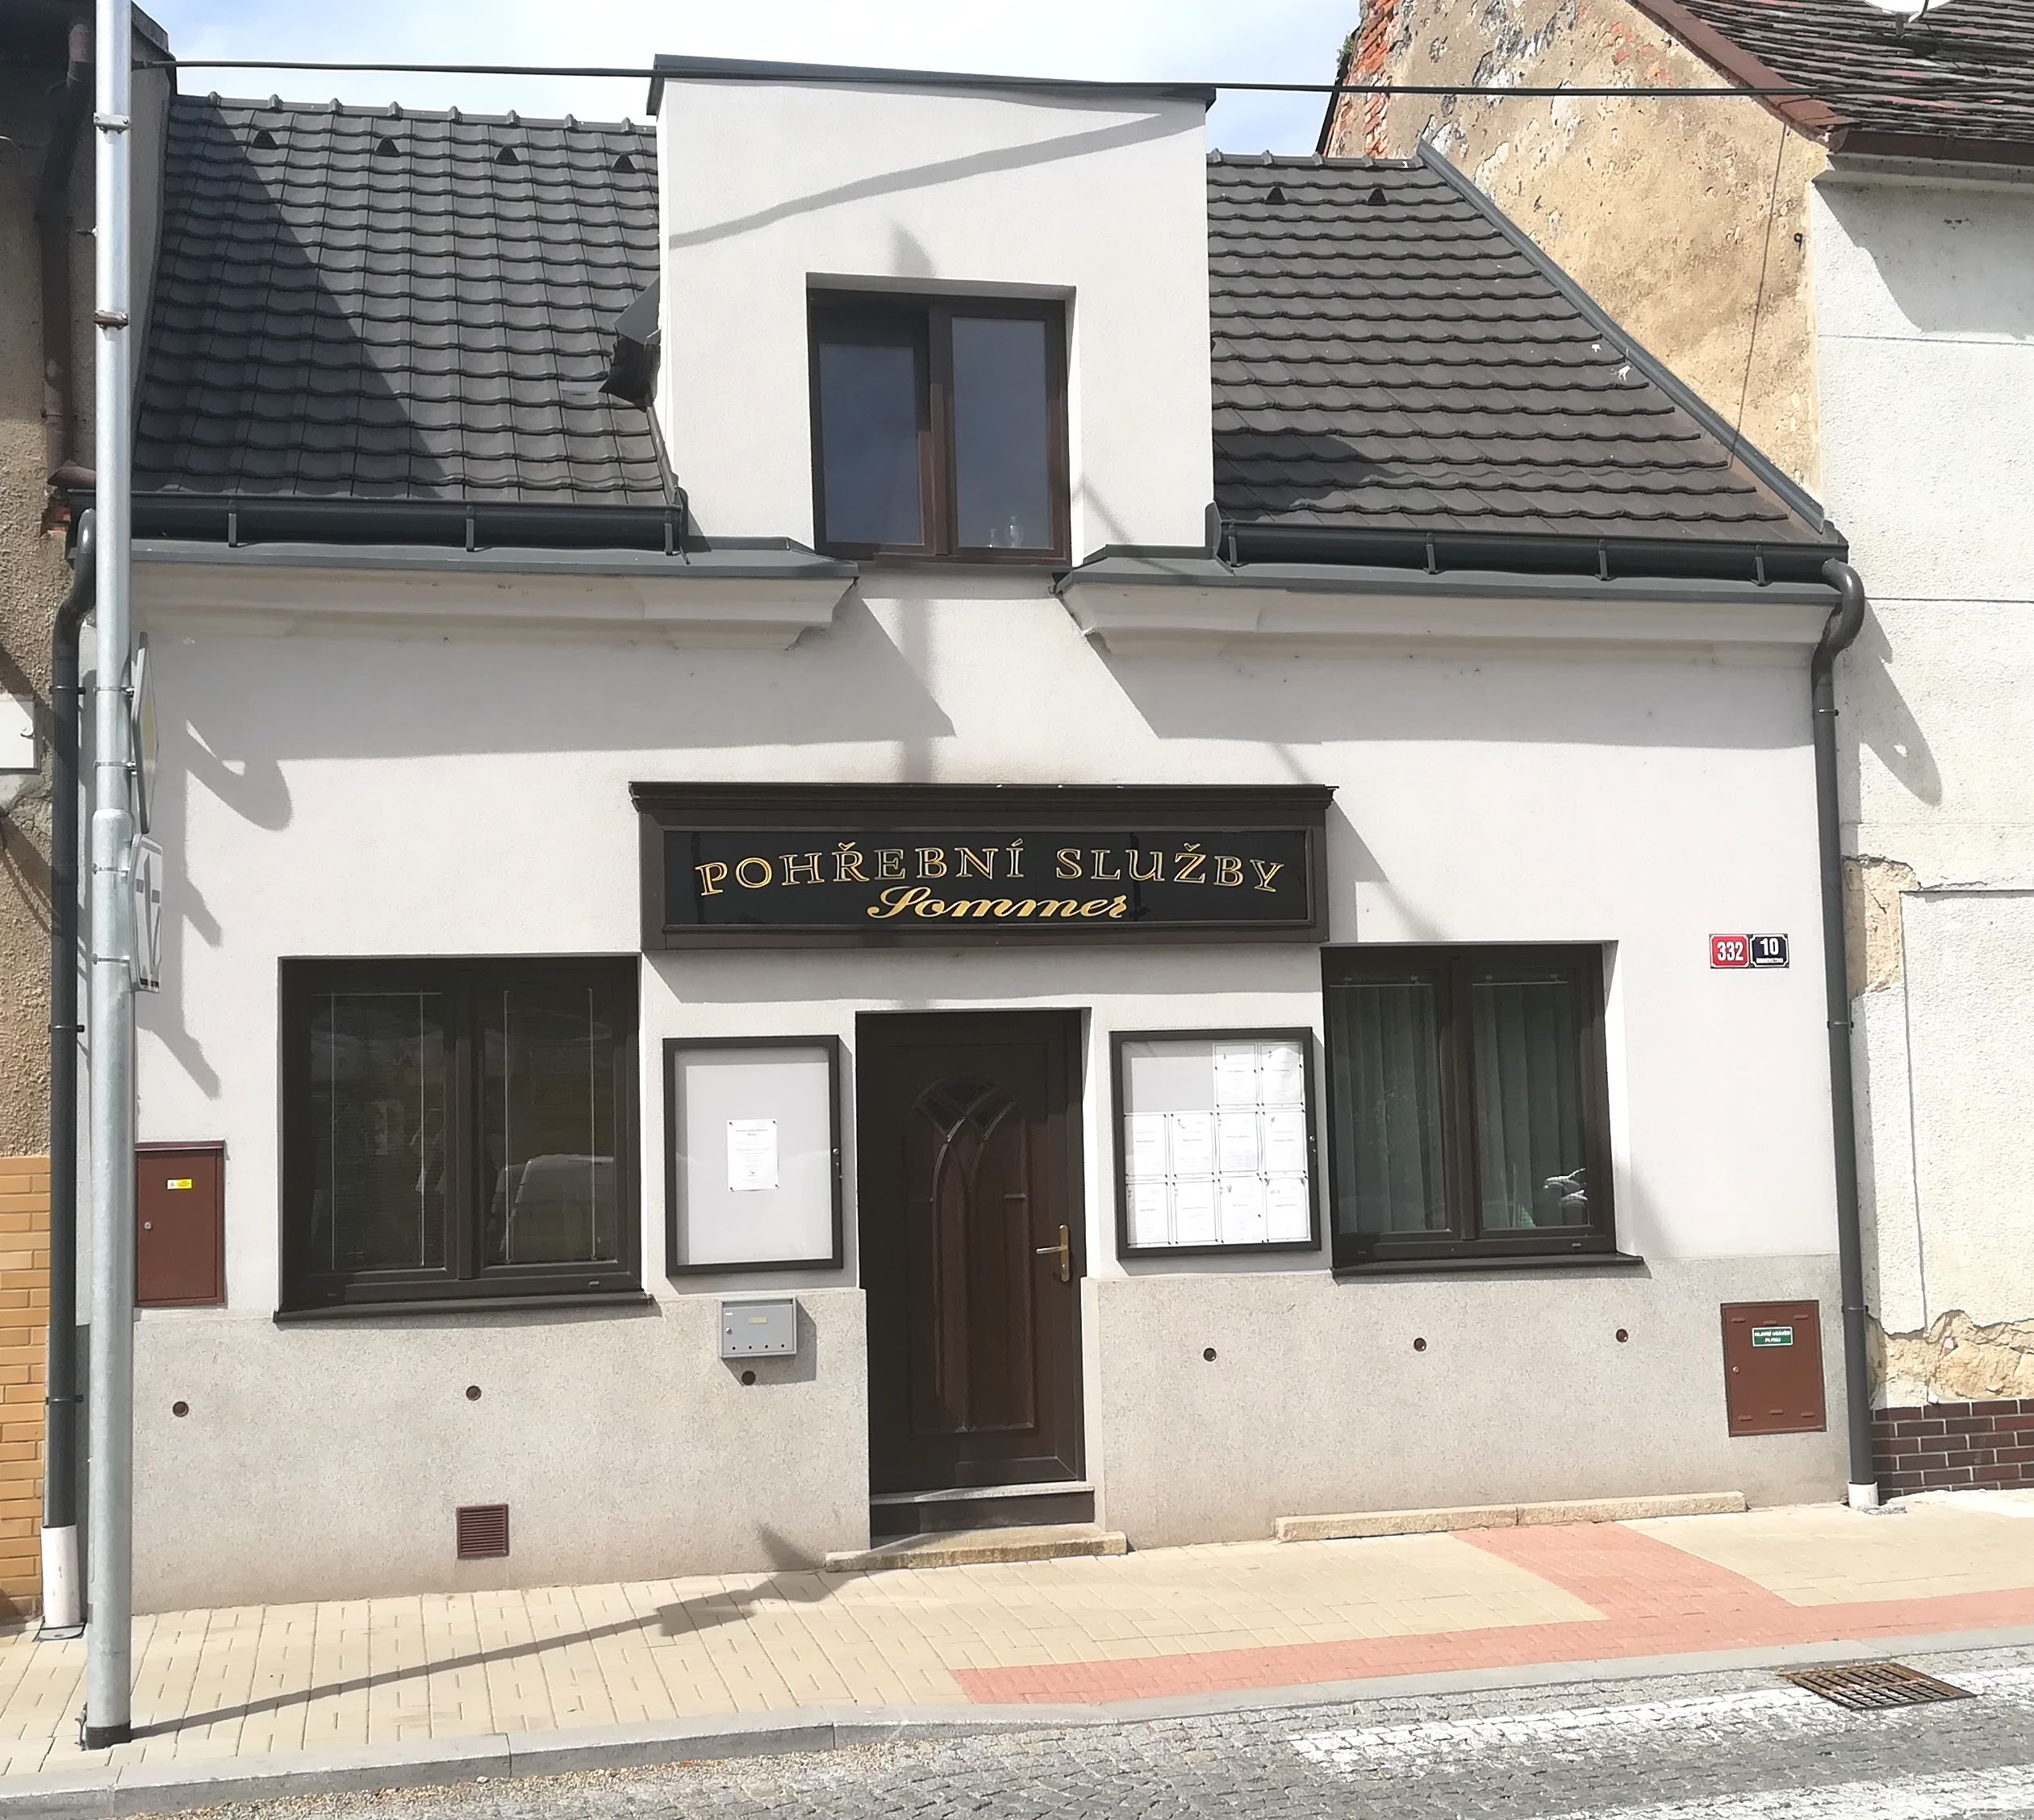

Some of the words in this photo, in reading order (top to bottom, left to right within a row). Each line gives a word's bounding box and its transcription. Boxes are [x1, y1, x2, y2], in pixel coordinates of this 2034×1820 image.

[694, 837, 1025, 896] POHŘEBNÍ
[1055, 842, 1285, 892] SLUŽBY
[866, 885, 1128, 919] Sommer
[1716, 941, 1744, 962] 332
[1760, 937, 1779, 956] 10
